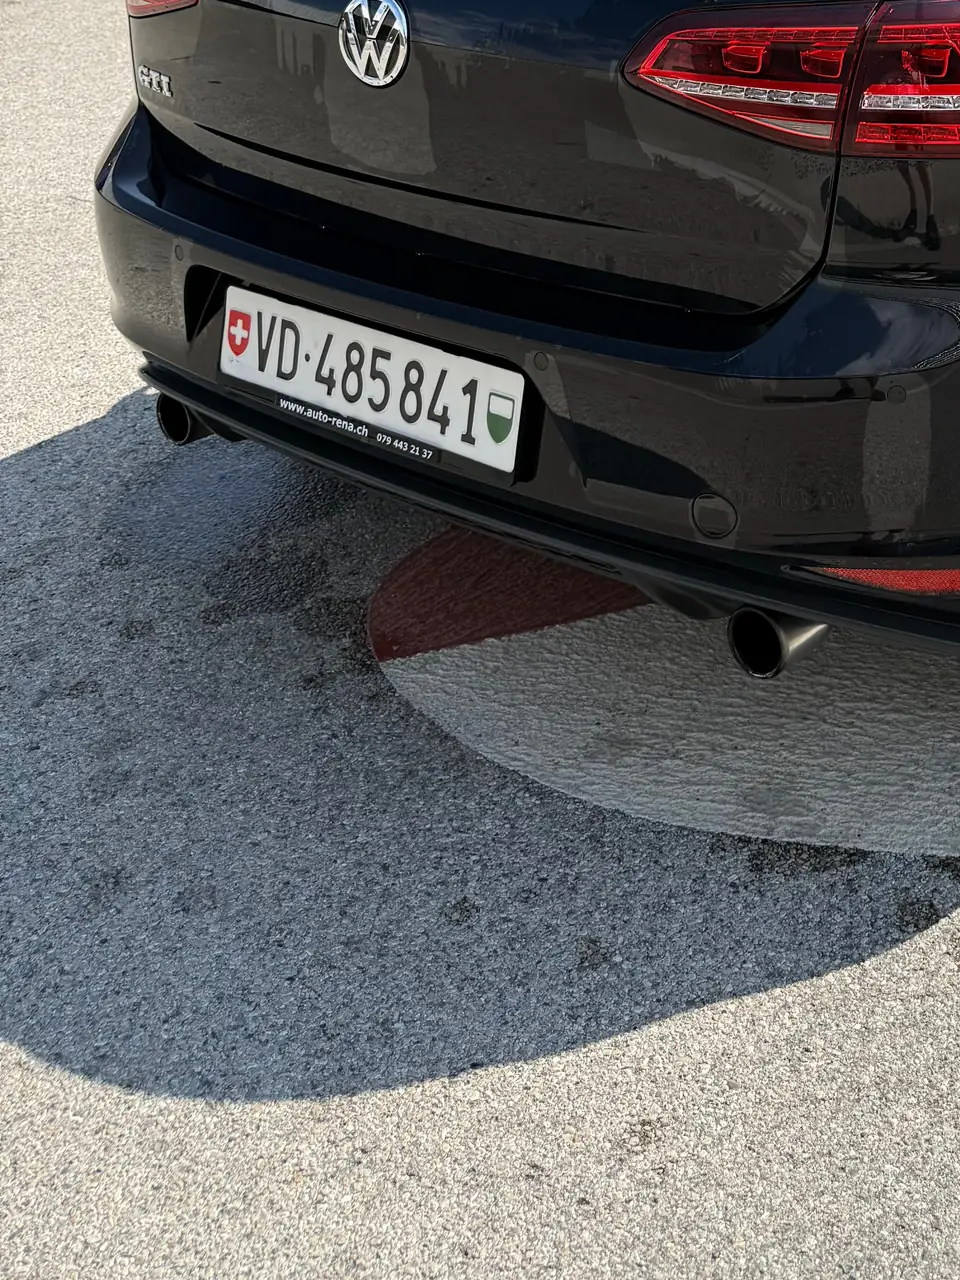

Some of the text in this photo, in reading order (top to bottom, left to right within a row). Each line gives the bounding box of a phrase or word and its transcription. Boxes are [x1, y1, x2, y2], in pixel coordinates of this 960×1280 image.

[138, 65, 173, 98] GTI
[279, 397, 433, 460] www.auto-rena.ch 079 443 21 37
